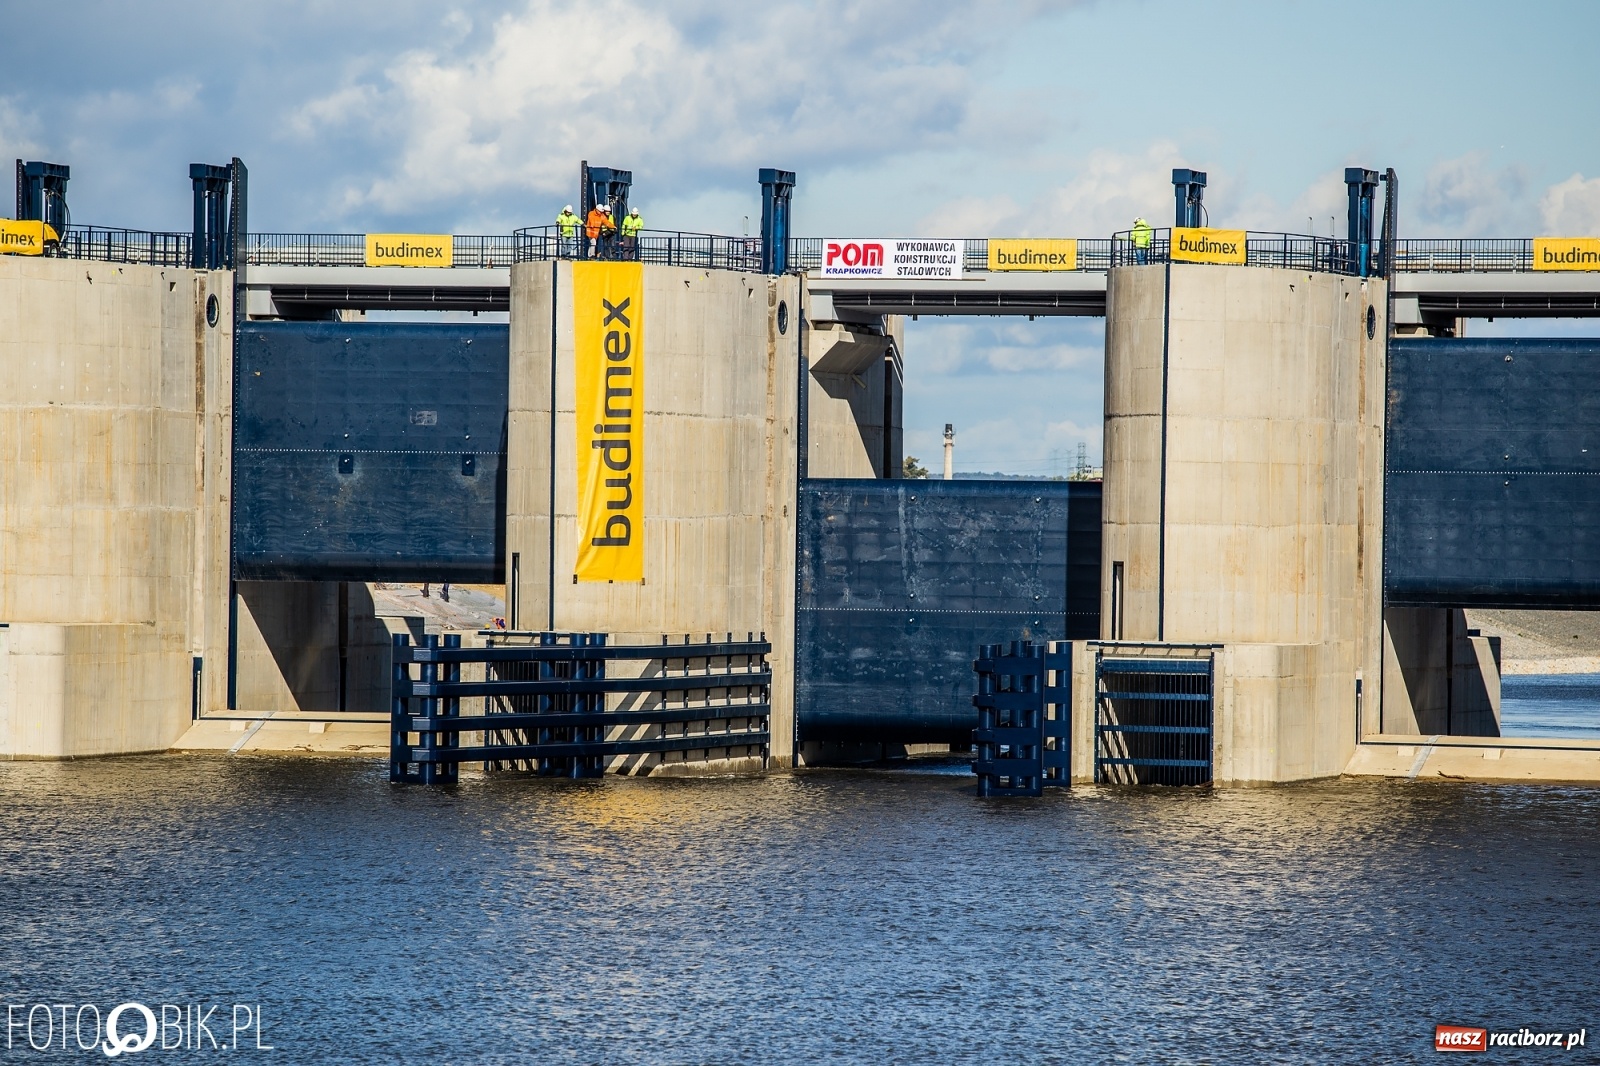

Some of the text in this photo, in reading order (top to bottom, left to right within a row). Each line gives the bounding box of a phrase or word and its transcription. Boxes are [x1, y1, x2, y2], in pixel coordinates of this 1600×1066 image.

[375, 242, 443, 258] budimex
[896, 242, 956, 252] WYKONAWCA
[1179, 235, 1237, 254] budimex
[827, 244, 883, 266] POM
[894, 254, 956, 264] KONSTRUKCJI
[997, 248, 1066, 265] budimex
[1543, 247, 1600, 263] budim
[897, 266, 952, 276] STALOWYCH
[592, 297, 632, 547] budimex
